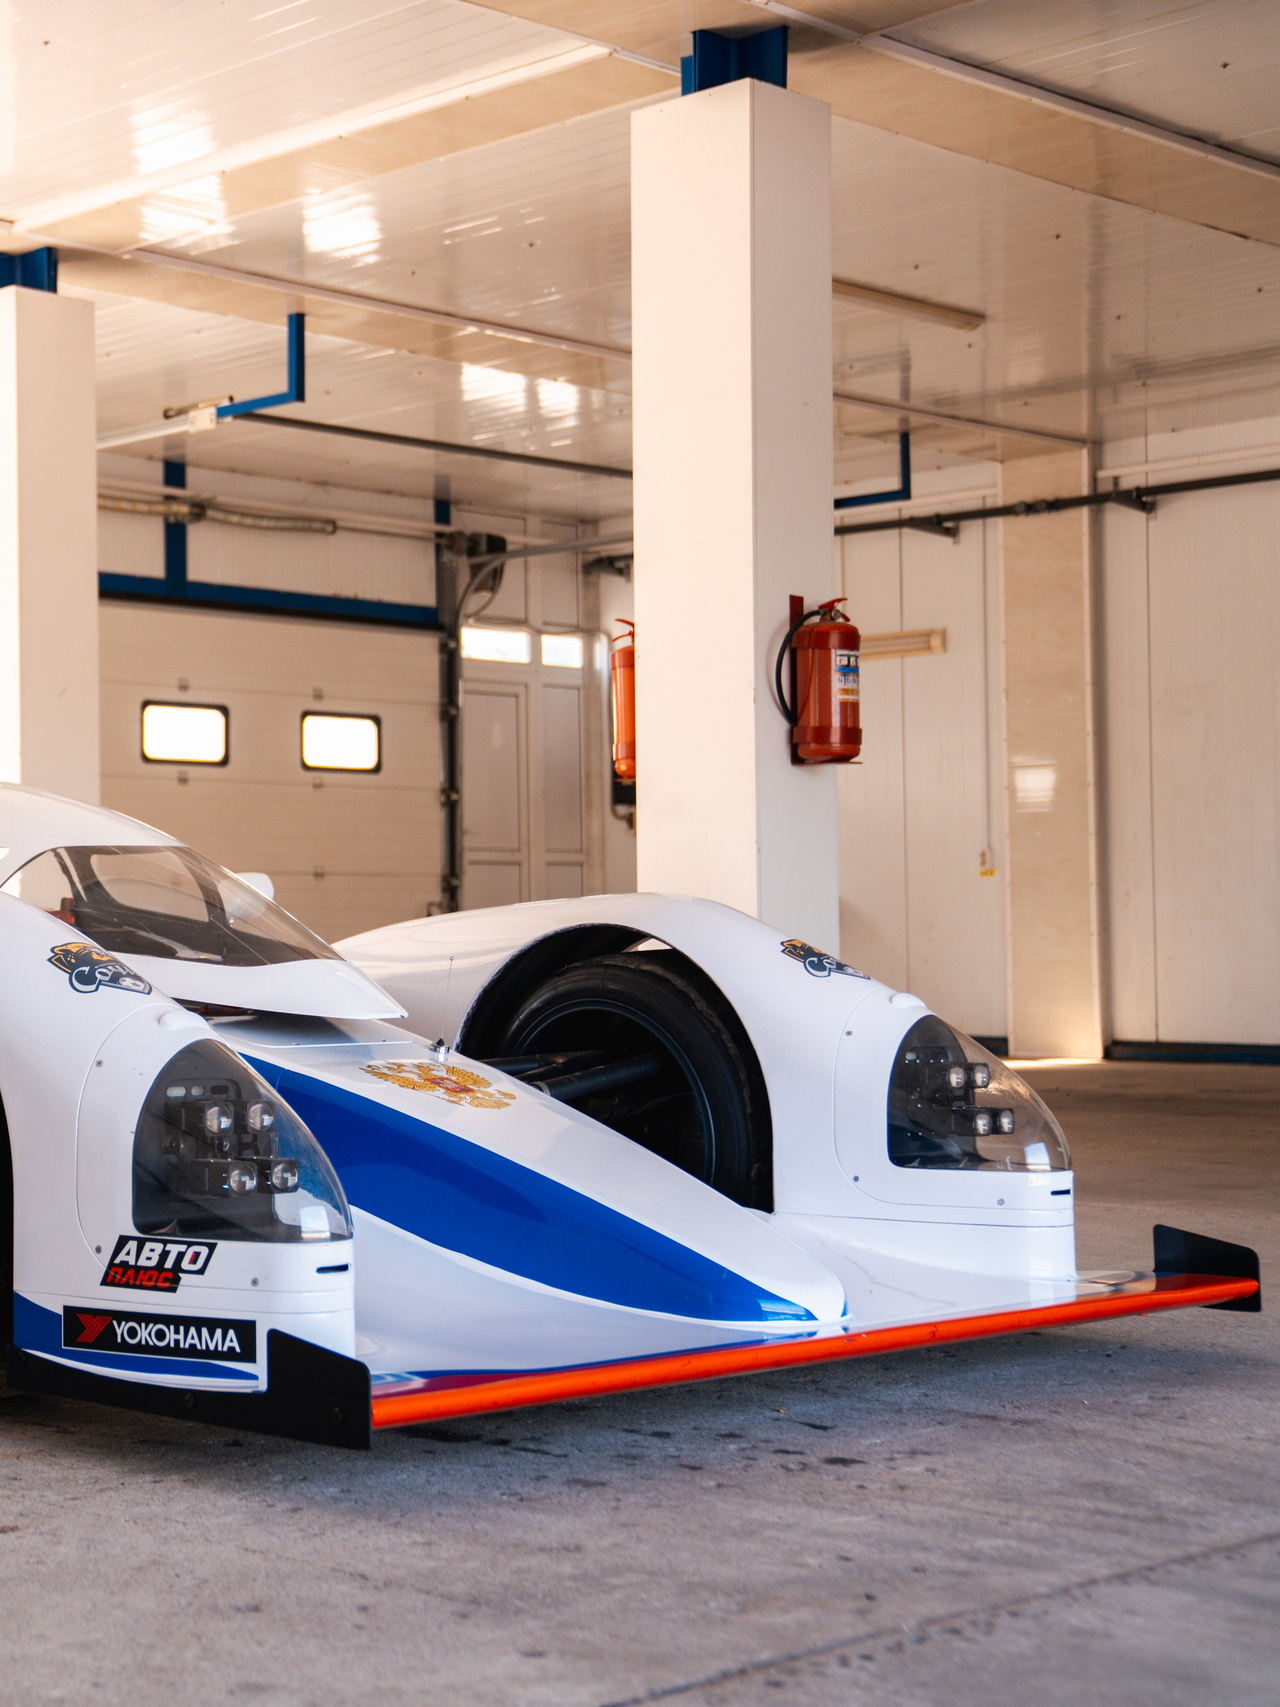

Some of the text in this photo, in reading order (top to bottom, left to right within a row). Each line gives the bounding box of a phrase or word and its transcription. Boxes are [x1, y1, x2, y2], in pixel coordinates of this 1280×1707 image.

[113, 1240, 209, 1271] АВТО
[106, 1267, 173, 1288] ПЛЮС
[112, 1319, 241, 1353] YOKOHAMA
